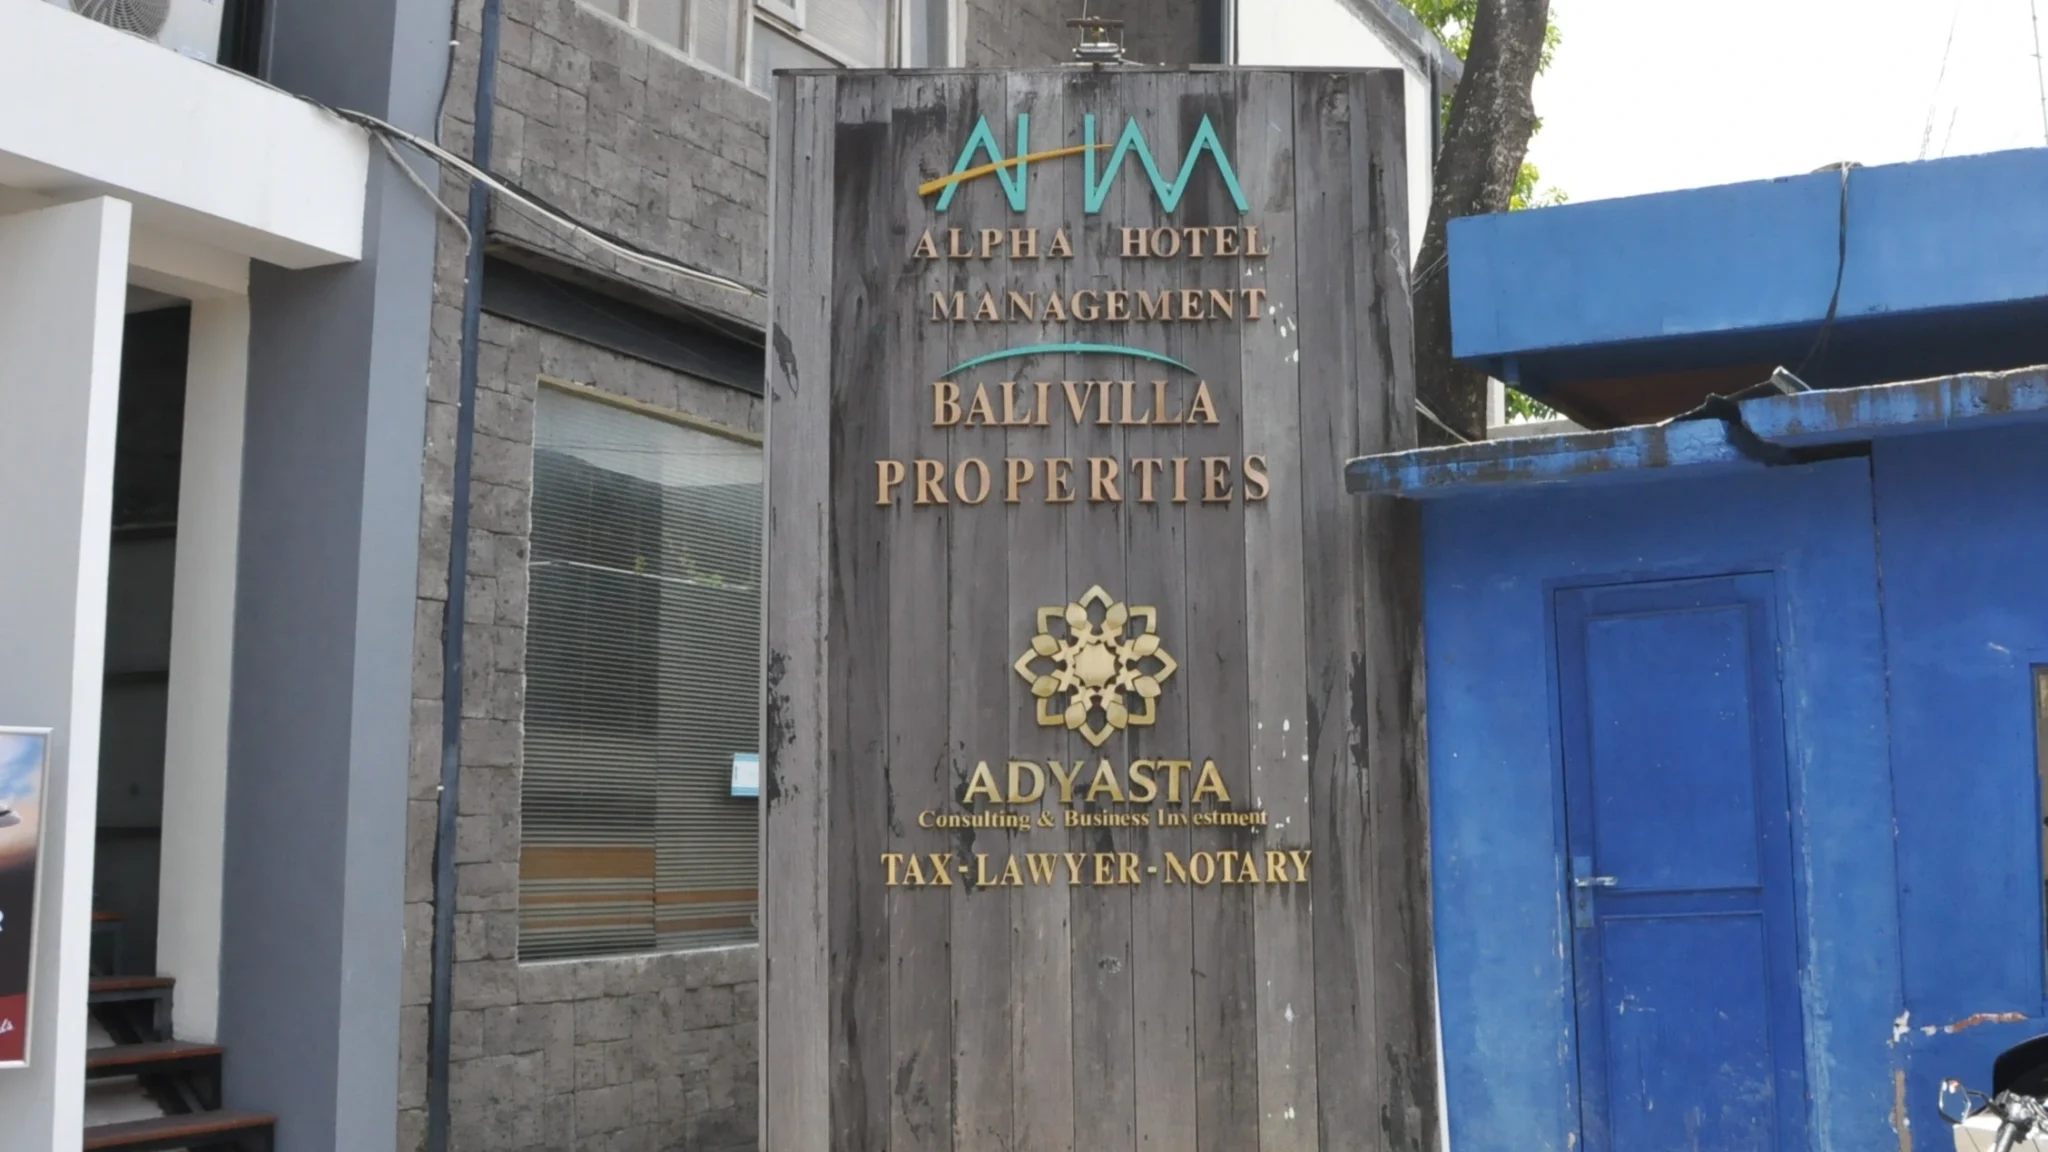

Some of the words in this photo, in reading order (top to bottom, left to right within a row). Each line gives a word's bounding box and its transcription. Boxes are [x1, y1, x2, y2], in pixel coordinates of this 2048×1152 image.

[913, 227, 1075, 260] ALPHA
[1120, 225, 1270, 259] HOTEL
[930, 287, 1267, 323] MANAGEMENT
[874, 453, 1272, 507] PROPERTIES
[962, 758, 1232, 804] ADYASTA
[917, 809, 1032, 832] Consulting
[1036, 810, 1056, 829] &
[1063, 809, 1150, 828] Business
[1156, 808, 1269, 827] Investment
